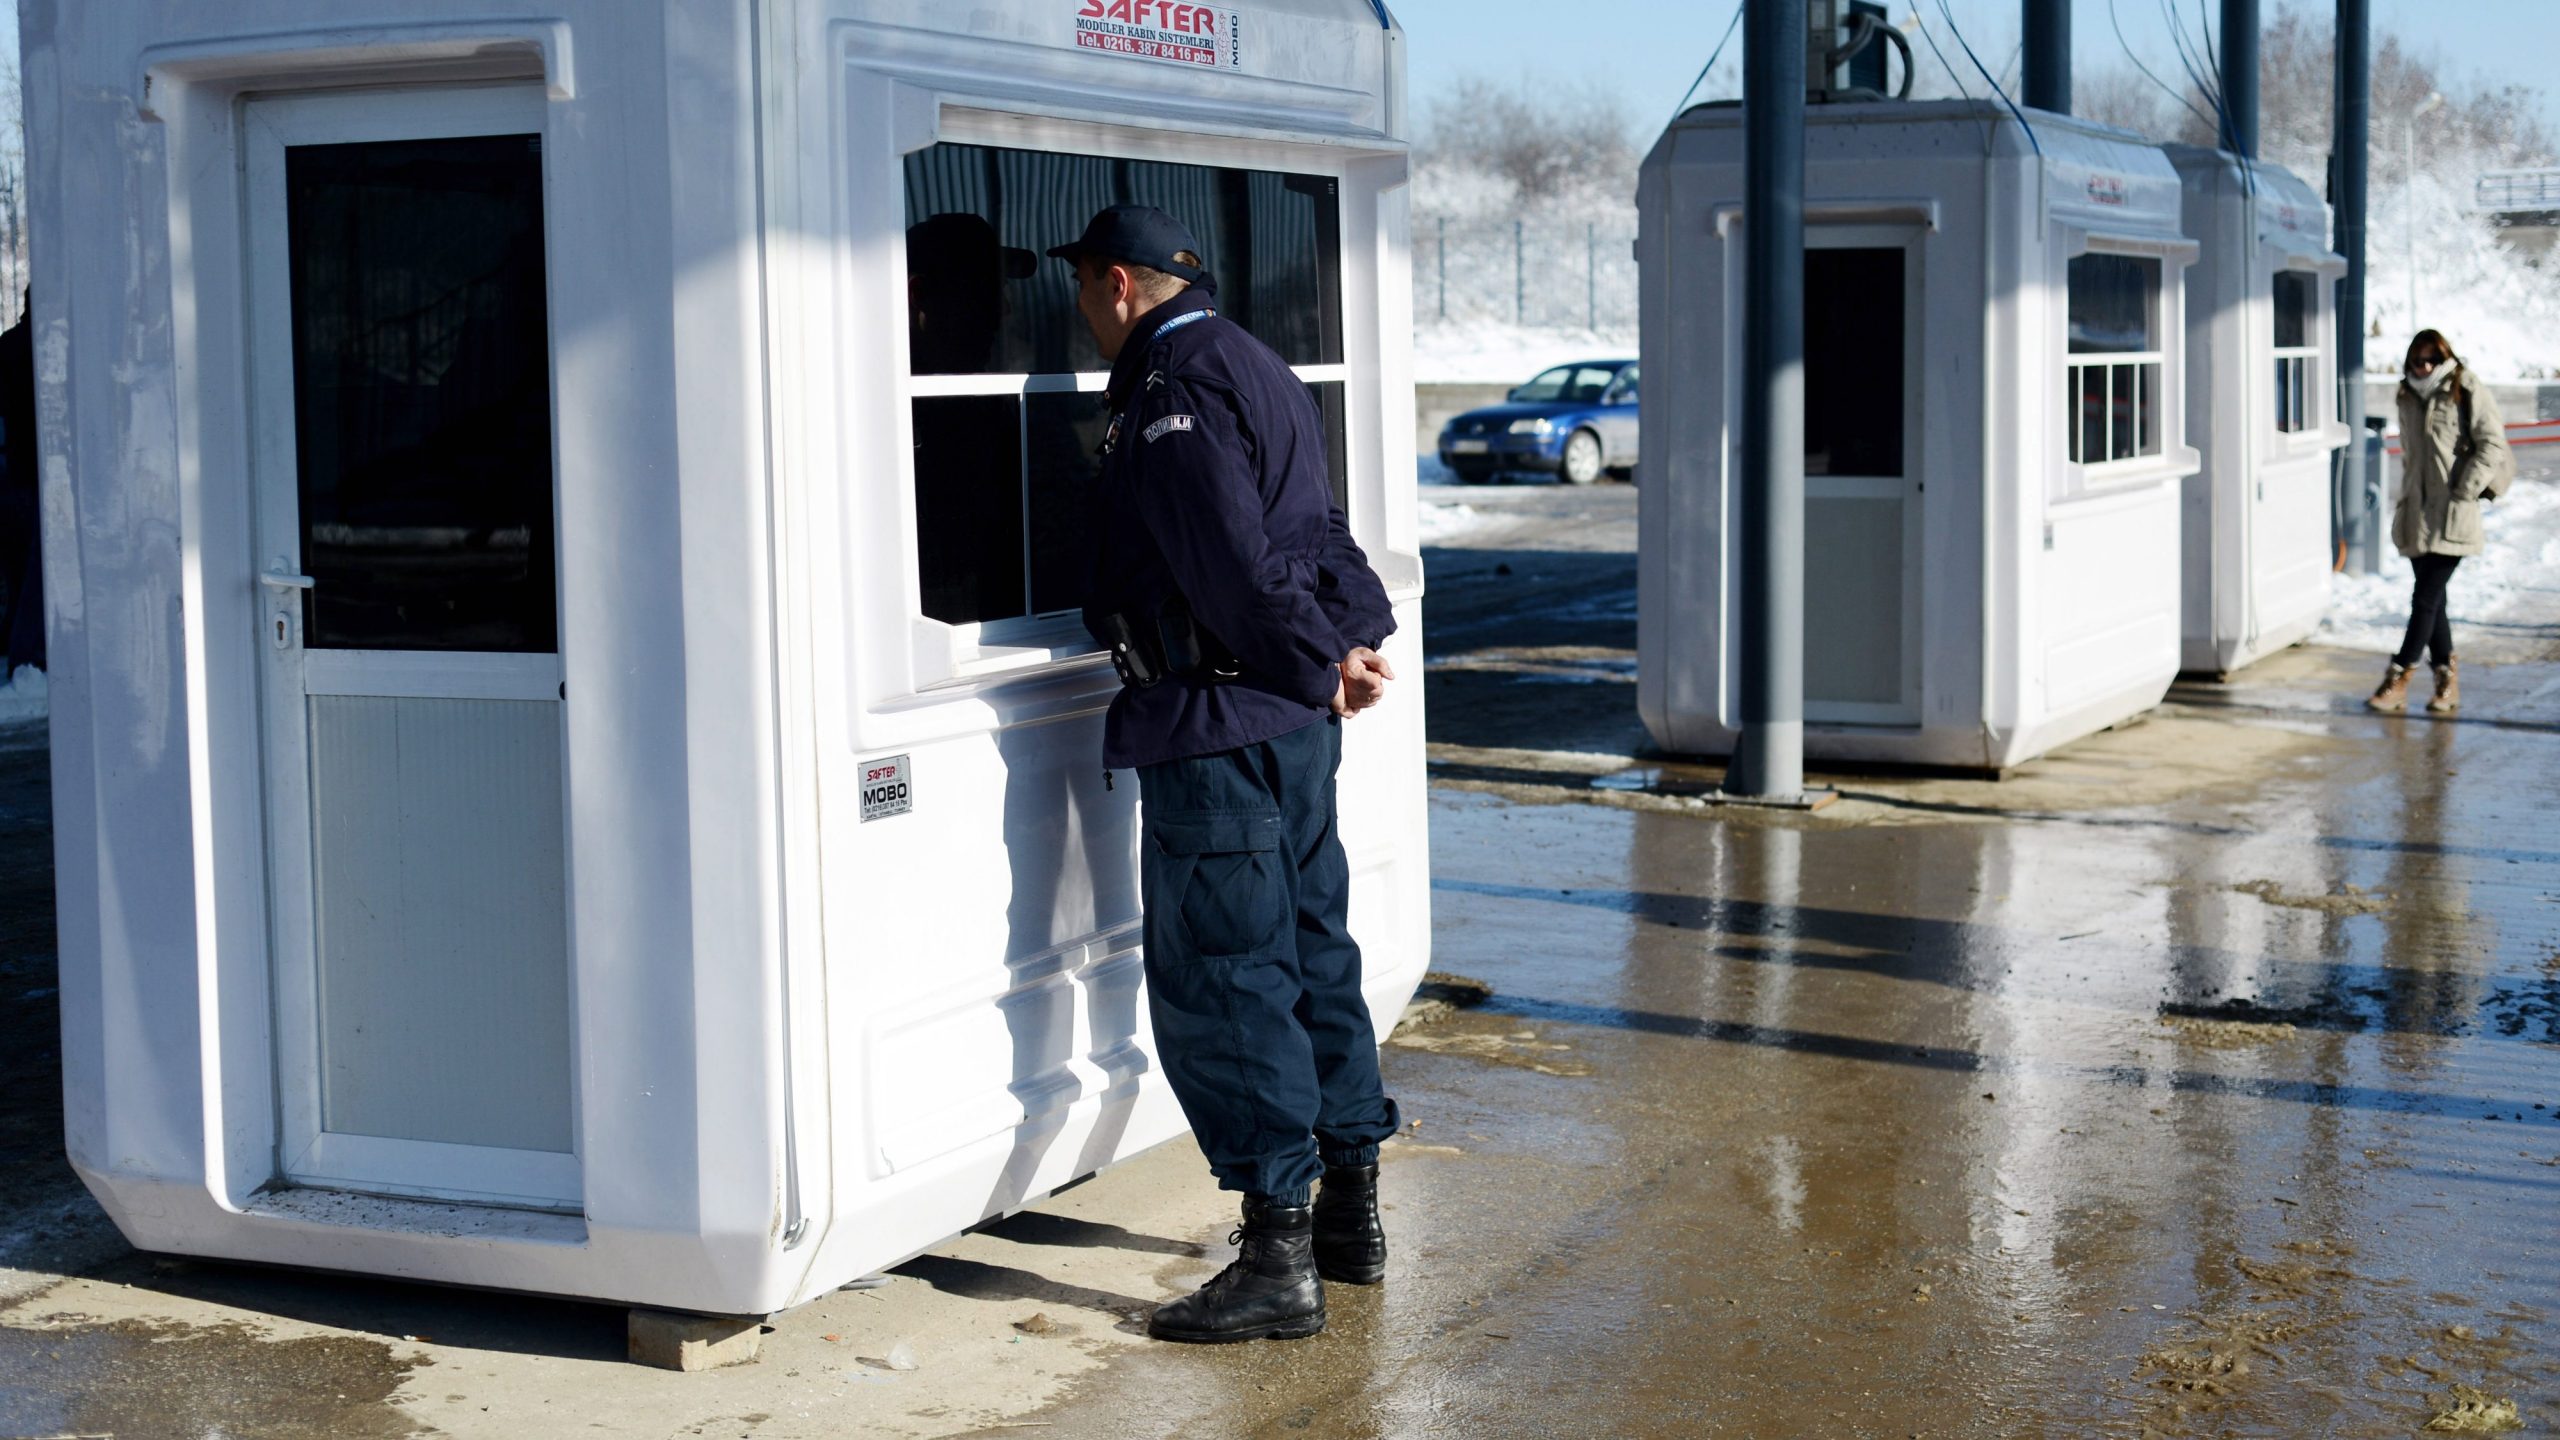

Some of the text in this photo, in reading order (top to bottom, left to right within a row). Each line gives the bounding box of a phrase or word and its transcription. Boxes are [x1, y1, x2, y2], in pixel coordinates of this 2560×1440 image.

[1076, 18, 1214, 50] MODÜLER KABİN SİSTEMLERİ
[1078, 0, 1215, 36] SAFTER
[1078, 31, 1214, 64] Tel. 0216. 387 84 16 pbx
[1231, 15, 1239, 66] MOBO
[866, 765, 896, 782] SAFTER
[863, 782, 907, 807] MOBO
